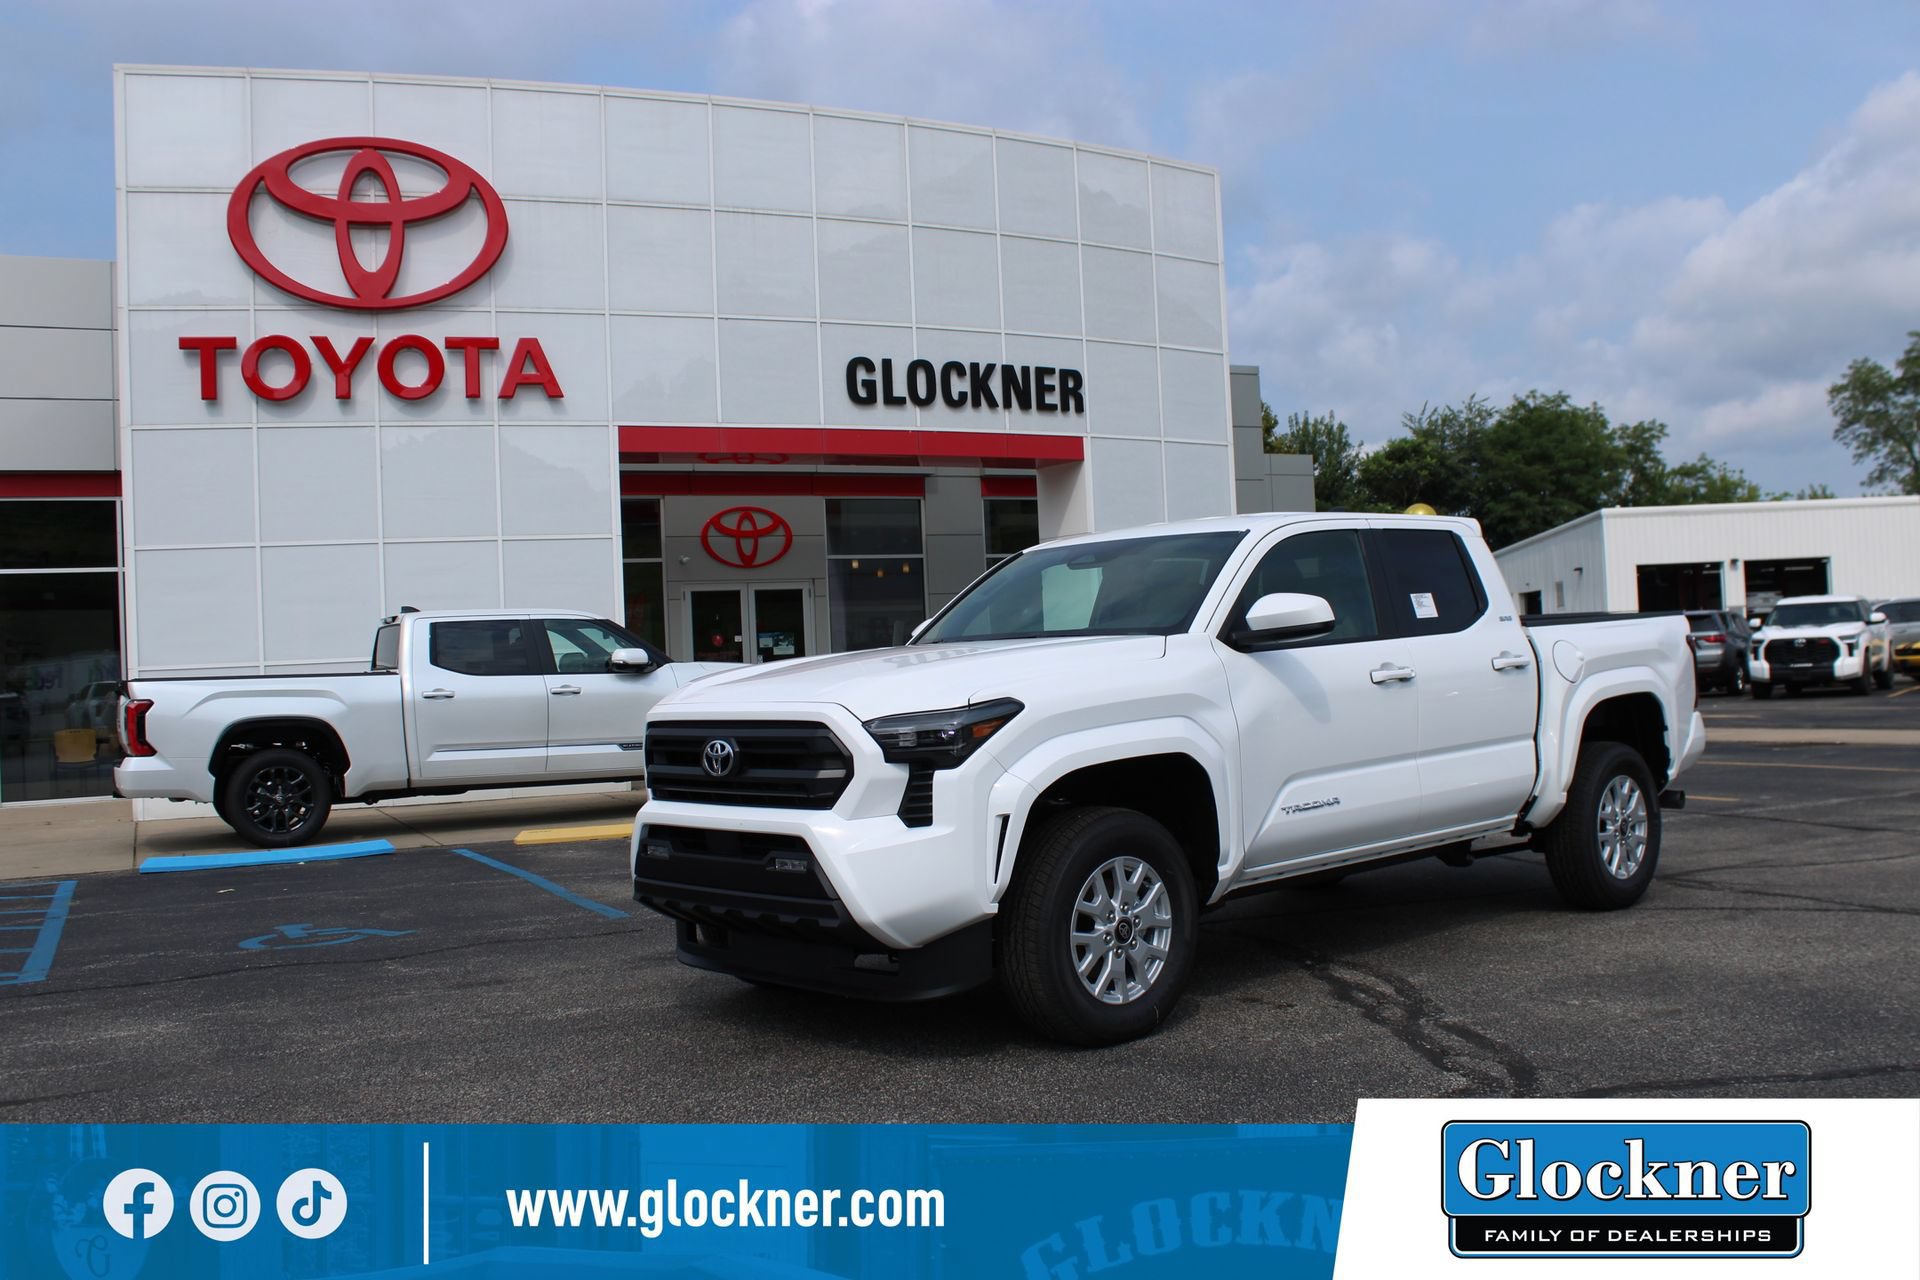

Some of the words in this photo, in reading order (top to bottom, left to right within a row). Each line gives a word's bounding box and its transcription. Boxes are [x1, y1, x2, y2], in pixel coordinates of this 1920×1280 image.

[178, 334, 565, 401] TOYOTA
[846, 356, 1085, 413] GLOCKNER
[1281, 796, 1341, 815] TACOMA
